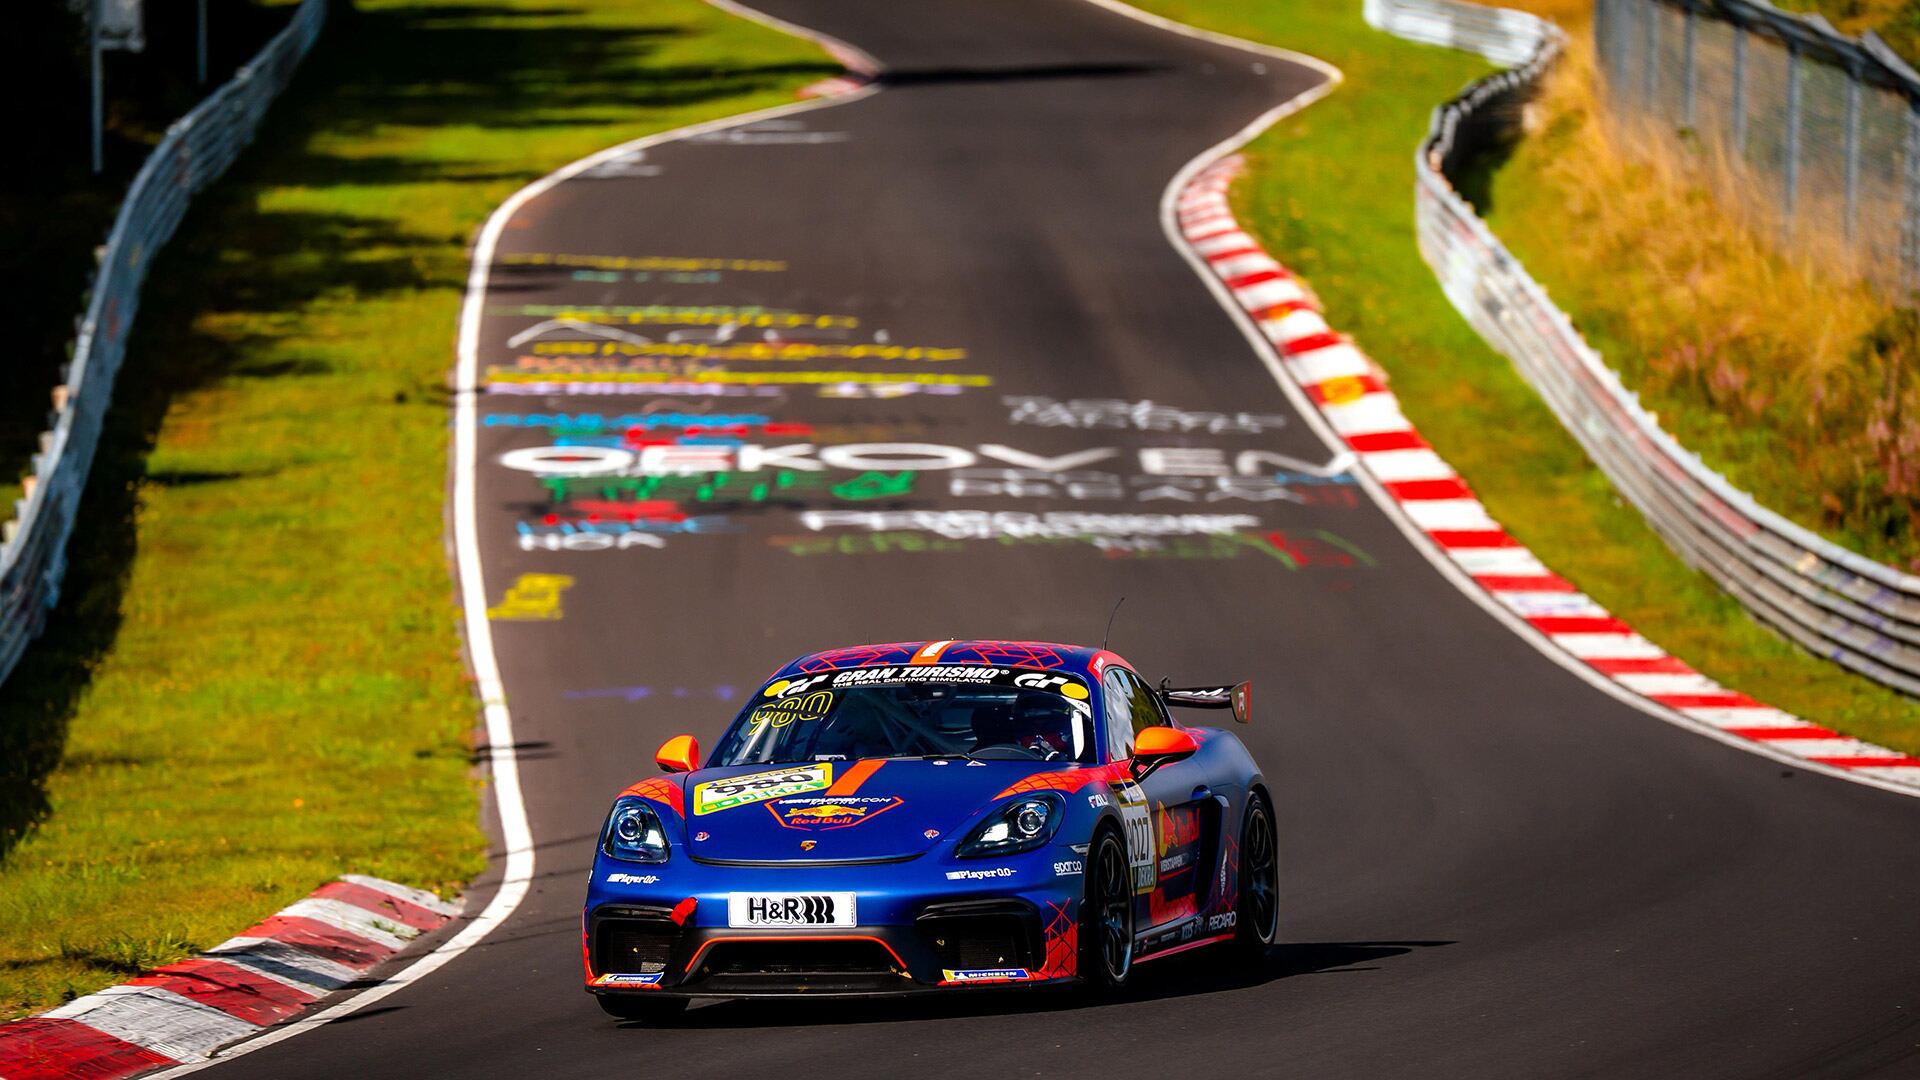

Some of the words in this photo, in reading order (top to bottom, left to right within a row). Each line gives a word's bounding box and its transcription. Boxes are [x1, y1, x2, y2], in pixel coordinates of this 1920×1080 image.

[498, 440, 1359, 479] OEKOVEN
[834, 668, 899, 683] GRAN
[853, 679, 882, 687] REAL
[883, 677, 927, 685] DRIVING
[929, 676, 993, 685] SIMULATOR
[748, 691, 834, 736] 980
[714, 774, 815, 797] 980
[737, 783, 818, 801] DEKRA
[790, 817, 822, 825] Red
[822, 816, 853, 824] Bull
[958, 869, 997, 880] Player
[1053, 861, 1082, 873] sparco
[749, 896, 803, 923] H&R
[967, 970, 1018, 978] MICHELIN
